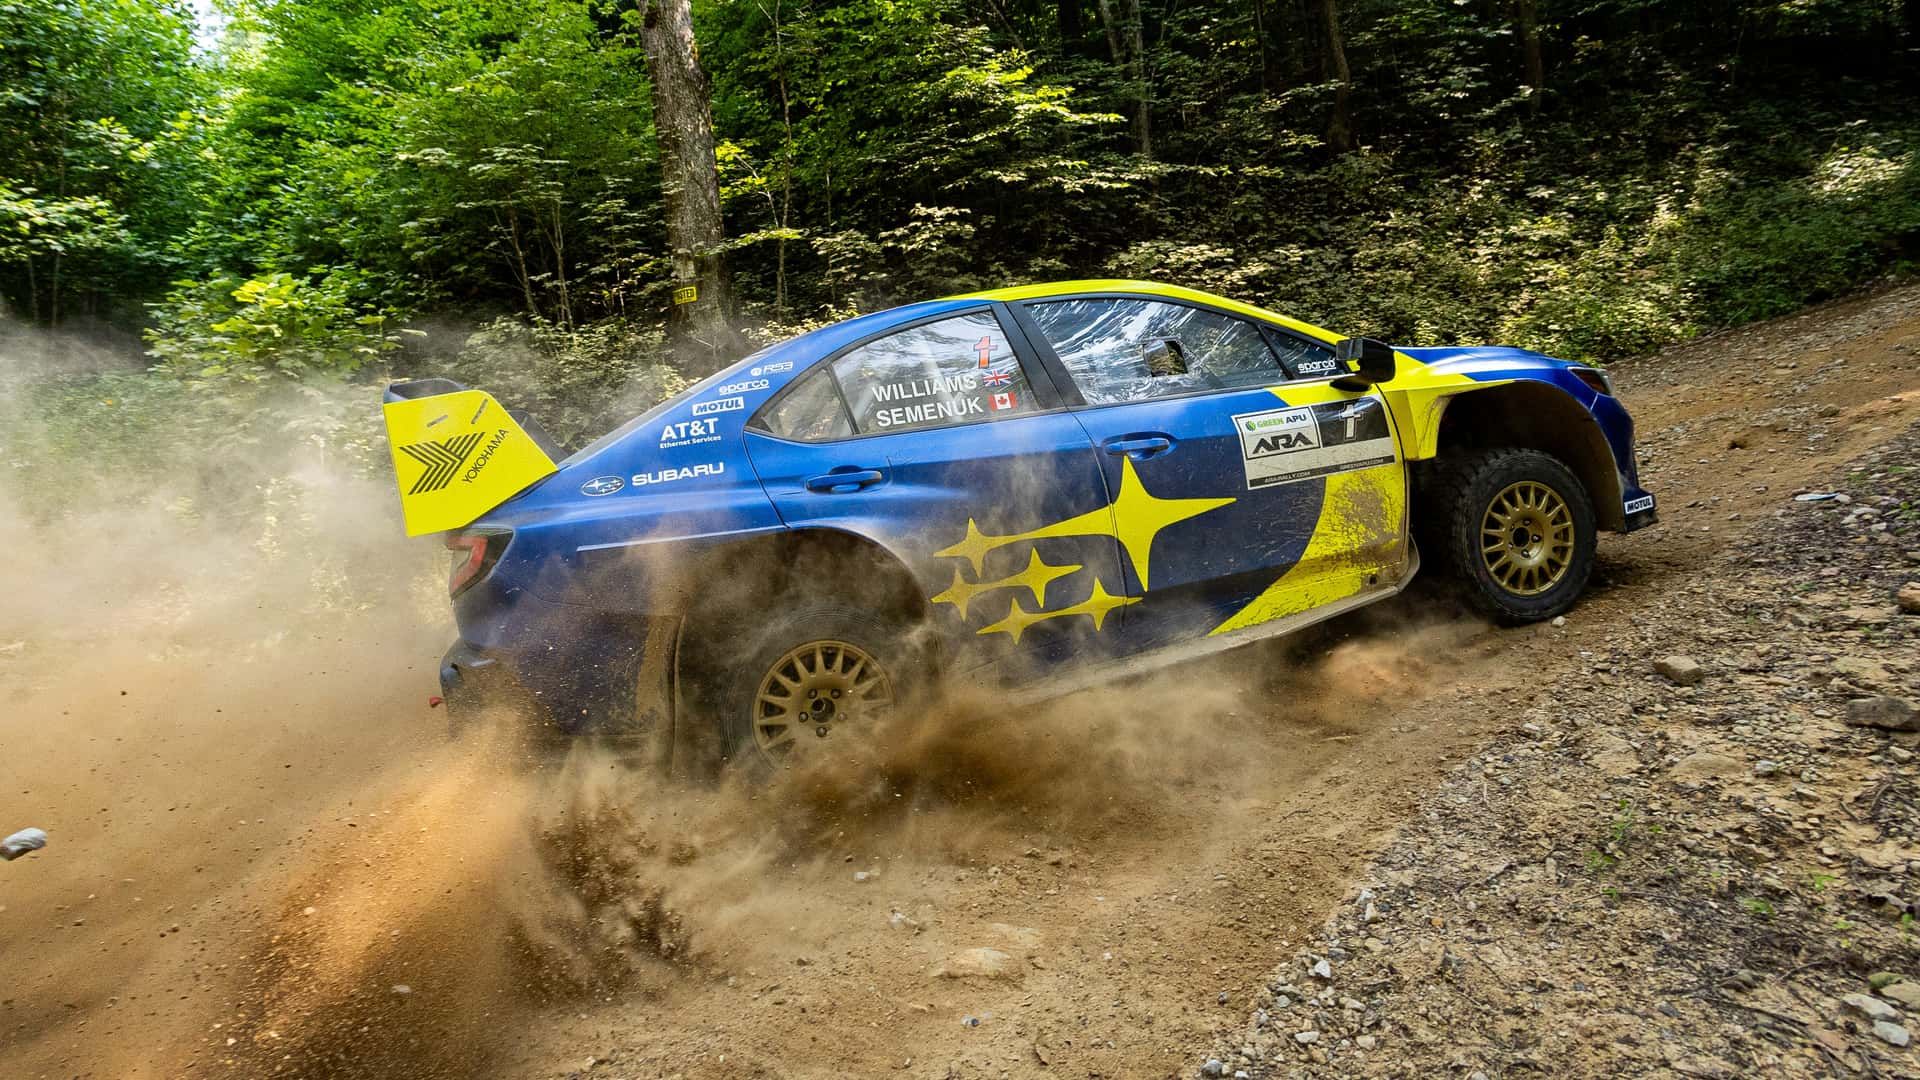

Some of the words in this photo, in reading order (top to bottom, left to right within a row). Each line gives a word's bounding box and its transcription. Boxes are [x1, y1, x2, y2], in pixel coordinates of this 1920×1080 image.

[973, 336, 999, 369] 1
[1297, 358, 1336, 373] sparco
[718, 379, 770, 395] sparco
[872, 374, 977, 402] WILLIAMS
[696, 400, 741, 413] MOTUL
[876, 396, 984, 427] SEMENUK
[660, 417, 719, 441] AT&T
[1256, 417, 1285, 429] GREEN
[1285, 413, 1307, 424] APU
[1339, 404, 1362, 438] 1
[660, 439, 691, 449] Ethernet
[692, 435, 721, 445] Services
[1252, 432, 1314, 455] ARA
[462, 428, 509, 484] YOKOHAMA
[632, 461, 724, 486] SUBARU
[1627, 497, 1651, 512] MOTUL
